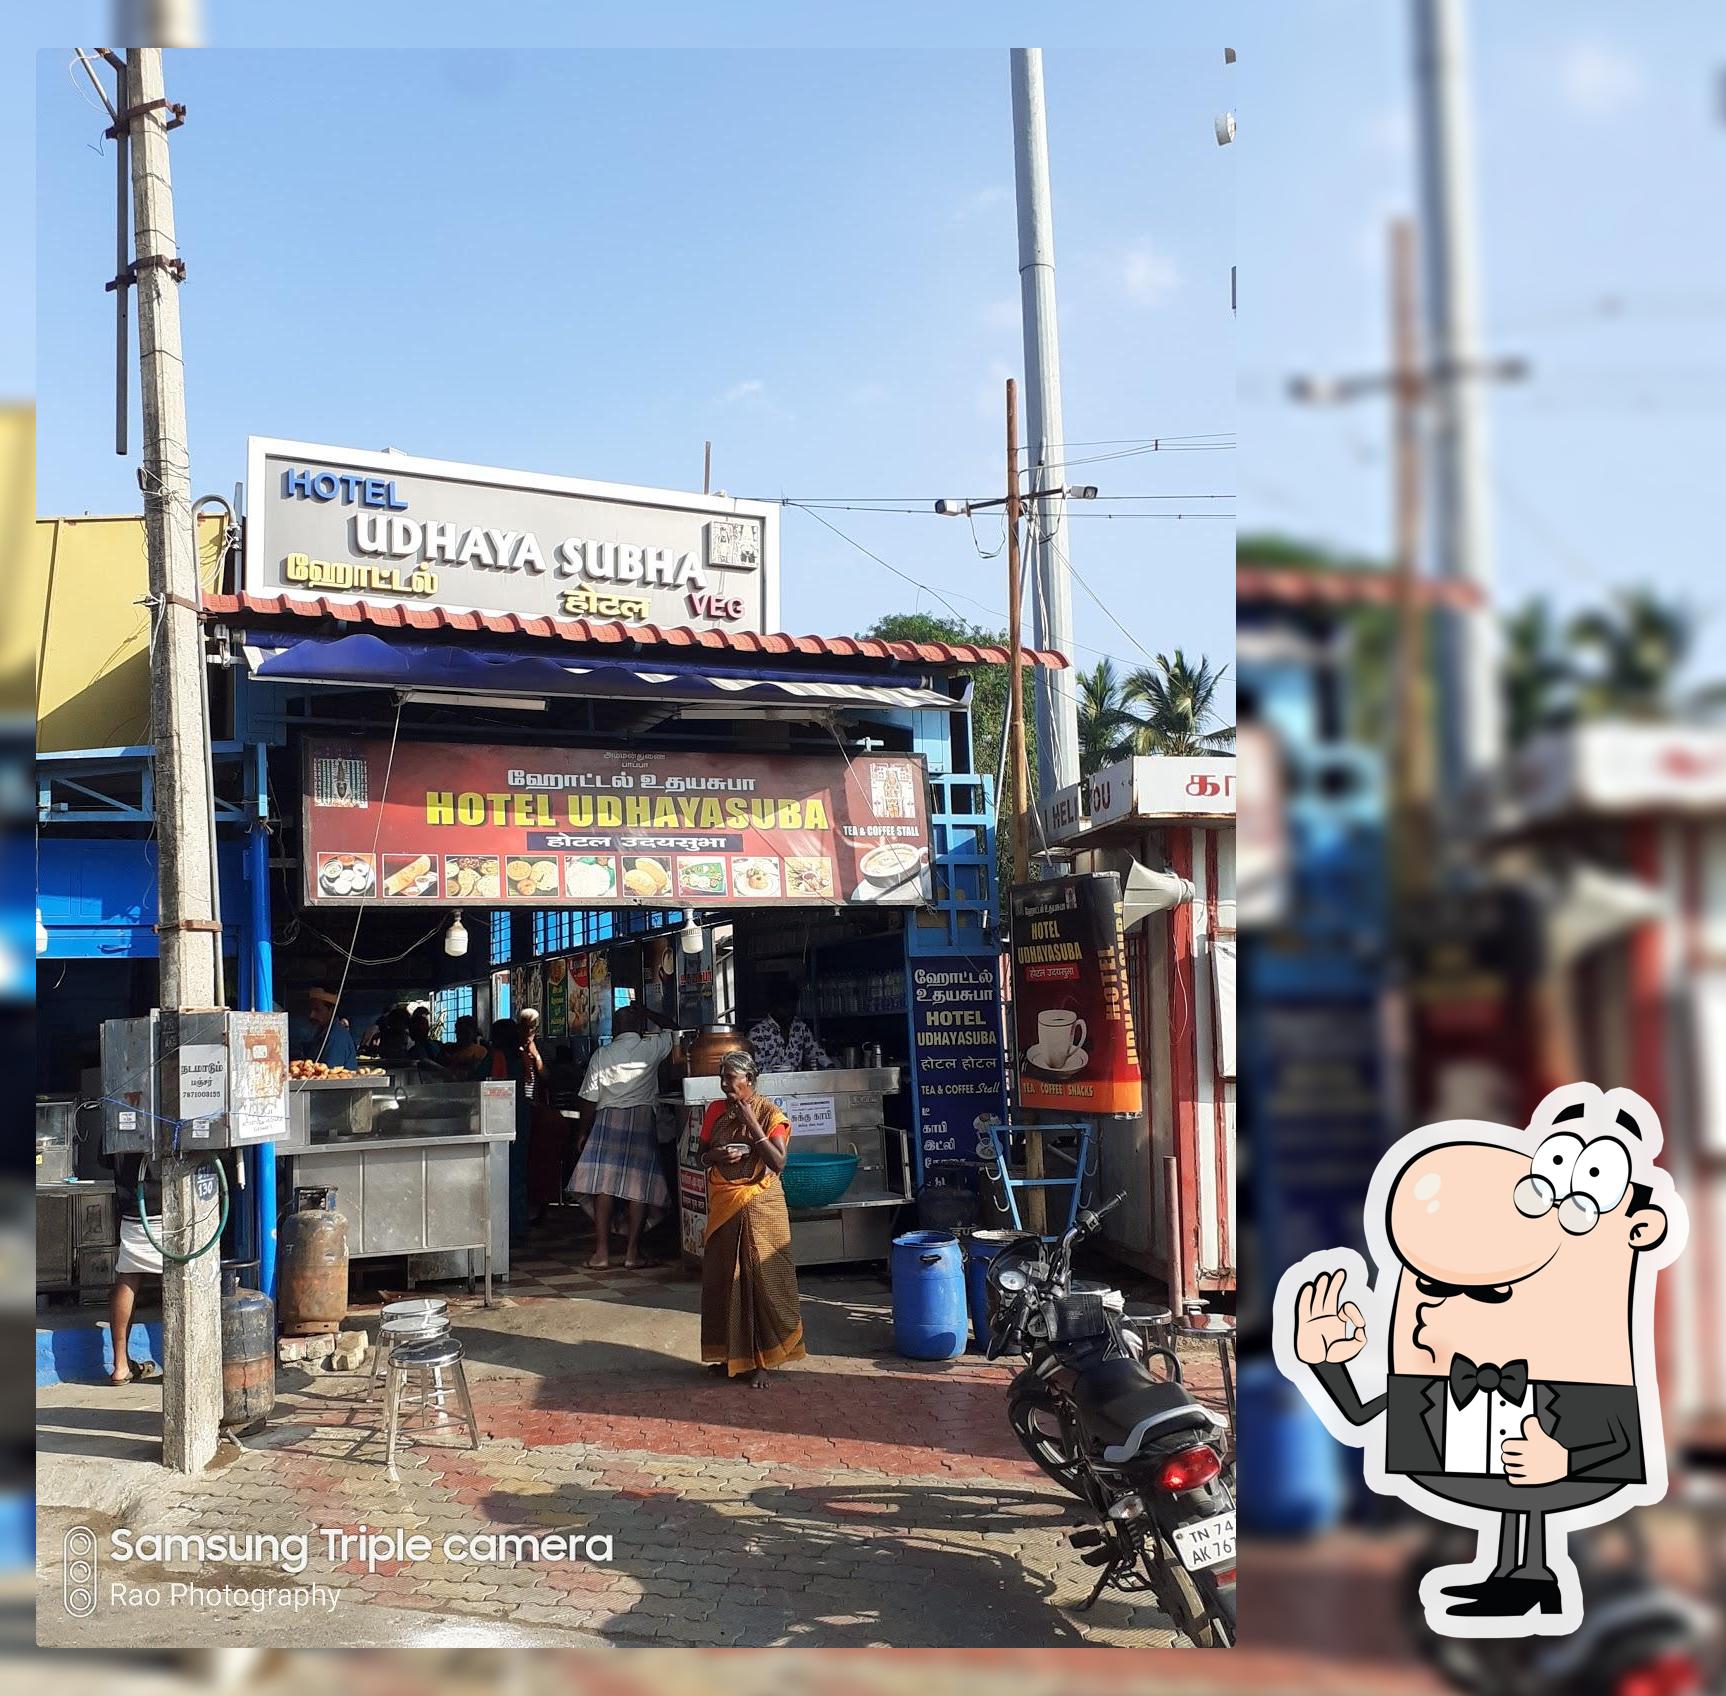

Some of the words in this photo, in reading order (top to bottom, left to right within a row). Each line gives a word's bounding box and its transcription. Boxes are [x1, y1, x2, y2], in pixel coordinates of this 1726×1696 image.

[285, 468, 408, 510] HOTEL
[353, 512, 546, 572] UDHAYA
[558, 537, 707, 589] SUBHA
[285, 552, 439, 595] ஹோட்டல்
[562, 583, 651, 619] होटल
[688, 593, 745, 620] VEG
[507, 769, 634, 790] ஹோட்டல்
[640, 773, 756, 793] உதயசுபா
[426, 791, 557, 827] HOTEL
[567, 794, 829, 831] UDHAYASUBA
[545, 832, 612, 848] होटल
[843, 825, 859, 836] TEA
[859, 826, 866, 836] &
[867, 825, 895, 836] COFFEE
[896, 825, 920, 837] STALL
[1031, 920, 1060, 940] HOTEL
[1017, 942, 1083, 964] UDHAYASUBA
[914, 968, 994, 988] ஹோட்டல்
[1097, 945, 1121, 1021] HOTEL
[916, 988, 994, 1005] உதயசுபா
[926, 1010, 987, 1026] HOTEL
[917, 1030, 997, 1046] UDHAYASUBA
[920, 1056, 958, 1071] होटल
[960, 1056, 998, 1071] होटल
[921, 1085, 936, 1095] TEA
[937, 1085, 944, 1095] &
[945, 1084, 975, 1095] COFFEE
[975, 1082, 1001, 1094] Stall
[1023, 1082, 1036, 1094] TEA
[1041, 1082, 1063, 1095] COFFEE
[1068, 1083, 1094, 1097] SNACKS
[922, 1121, 948, 1134] காபி
[924, 1137, 956, 1151] இட்லி
[198, 1181, 213, 1197] 130
[1189, 1528, 1210, 1543] TN
[1213, 1520, 1234, 1536] 74
[1192, 1546, 1212, 1565] AK
